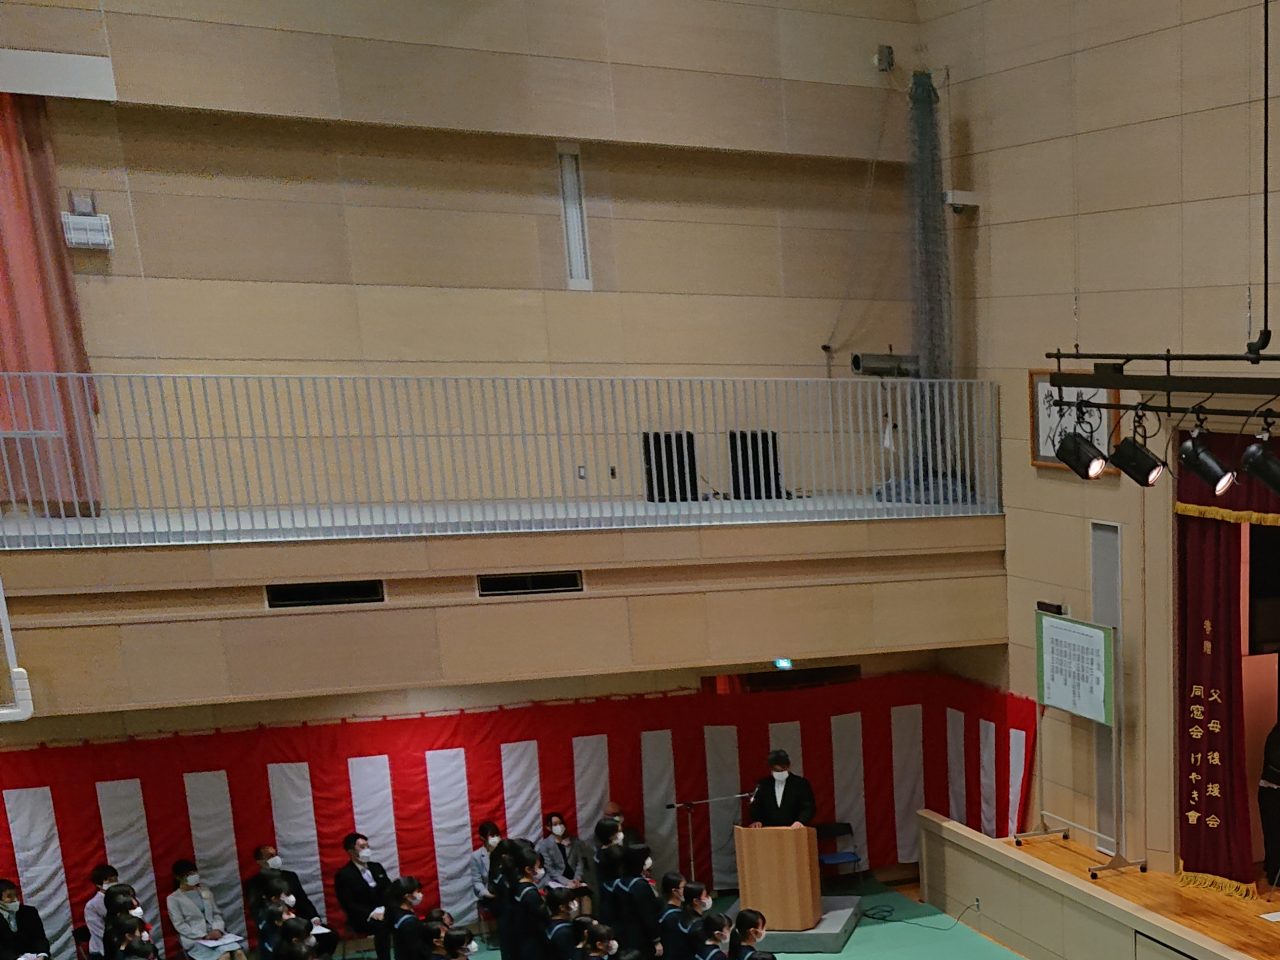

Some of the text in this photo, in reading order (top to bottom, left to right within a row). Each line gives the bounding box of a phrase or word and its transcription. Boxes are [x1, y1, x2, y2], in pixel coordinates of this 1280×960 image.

[1188, 685, 1205, 739] 同窓会
[1205, 689, 1222, 828] 父母後援会
